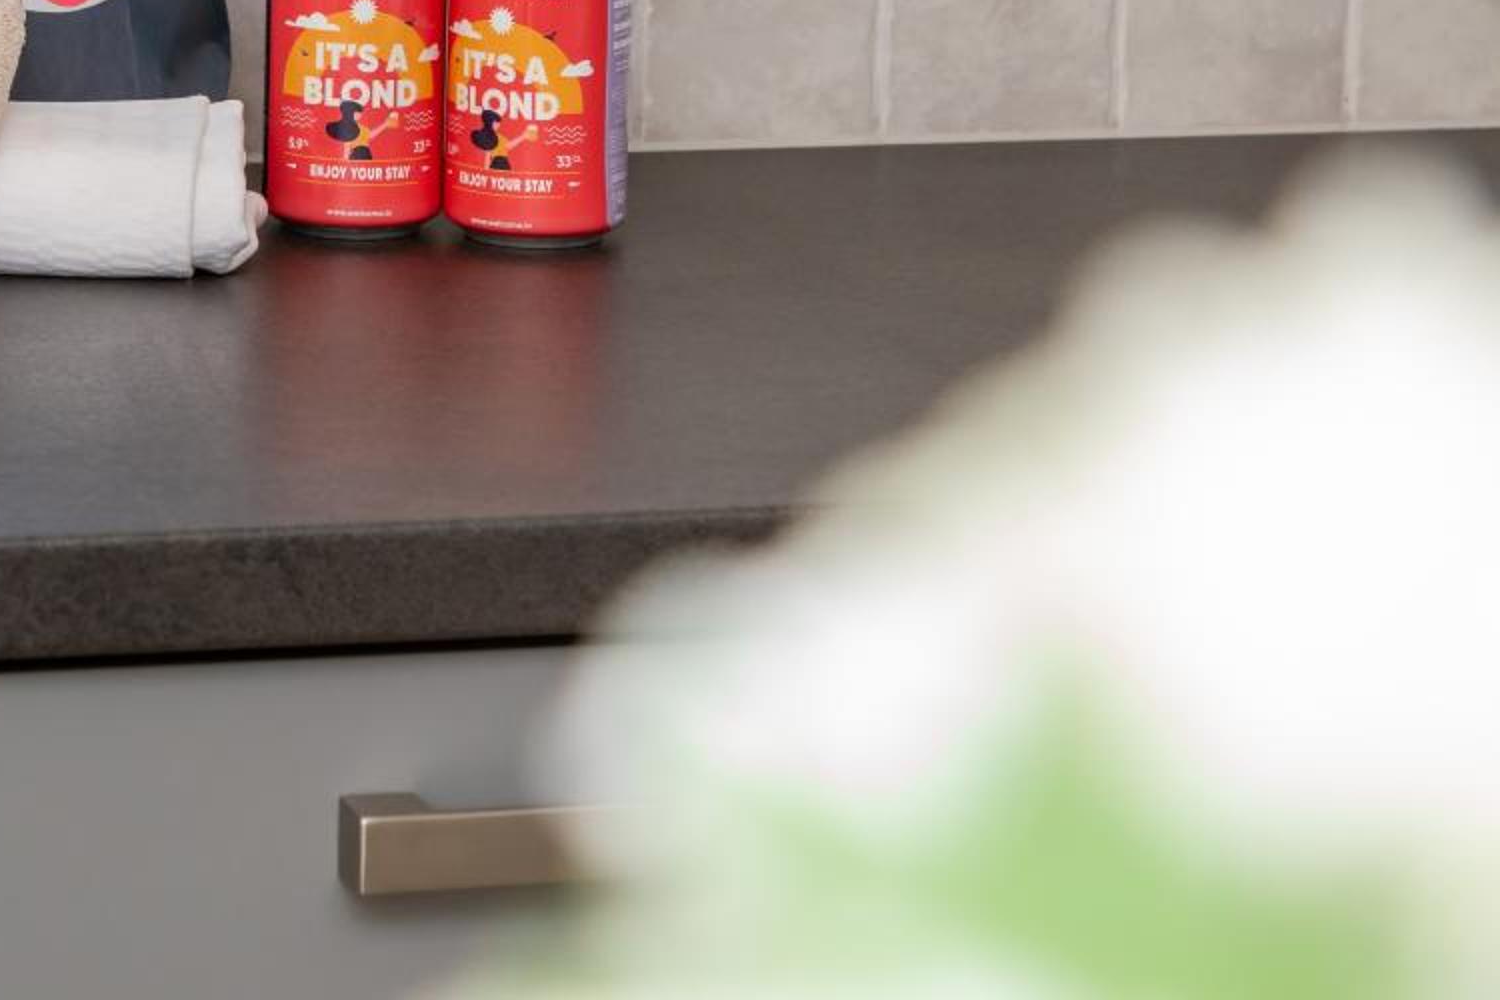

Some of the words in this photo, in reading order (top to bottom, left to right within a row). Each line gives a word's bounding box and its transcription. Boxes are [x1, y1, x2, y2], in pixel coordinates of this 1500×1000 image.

[316, 42, 379, 73] IT'S
[386, 43, 408, 72] A
[463, 49, 516, 84] IT'S
[523, 55, 549, 85] A
[303, 77, 418, 109] BLOND
[455, 83, 560, 121] BLOND
[309, 164, 347, 178] ENJOY
[350, 166, 383, 180] YOUR
[385, 166, 411, 179] STAY
[458, 171, 487, 186] ENJOY
[490, 175, 521, 191] YOUR
[525, 179, 553, 192] STAY
